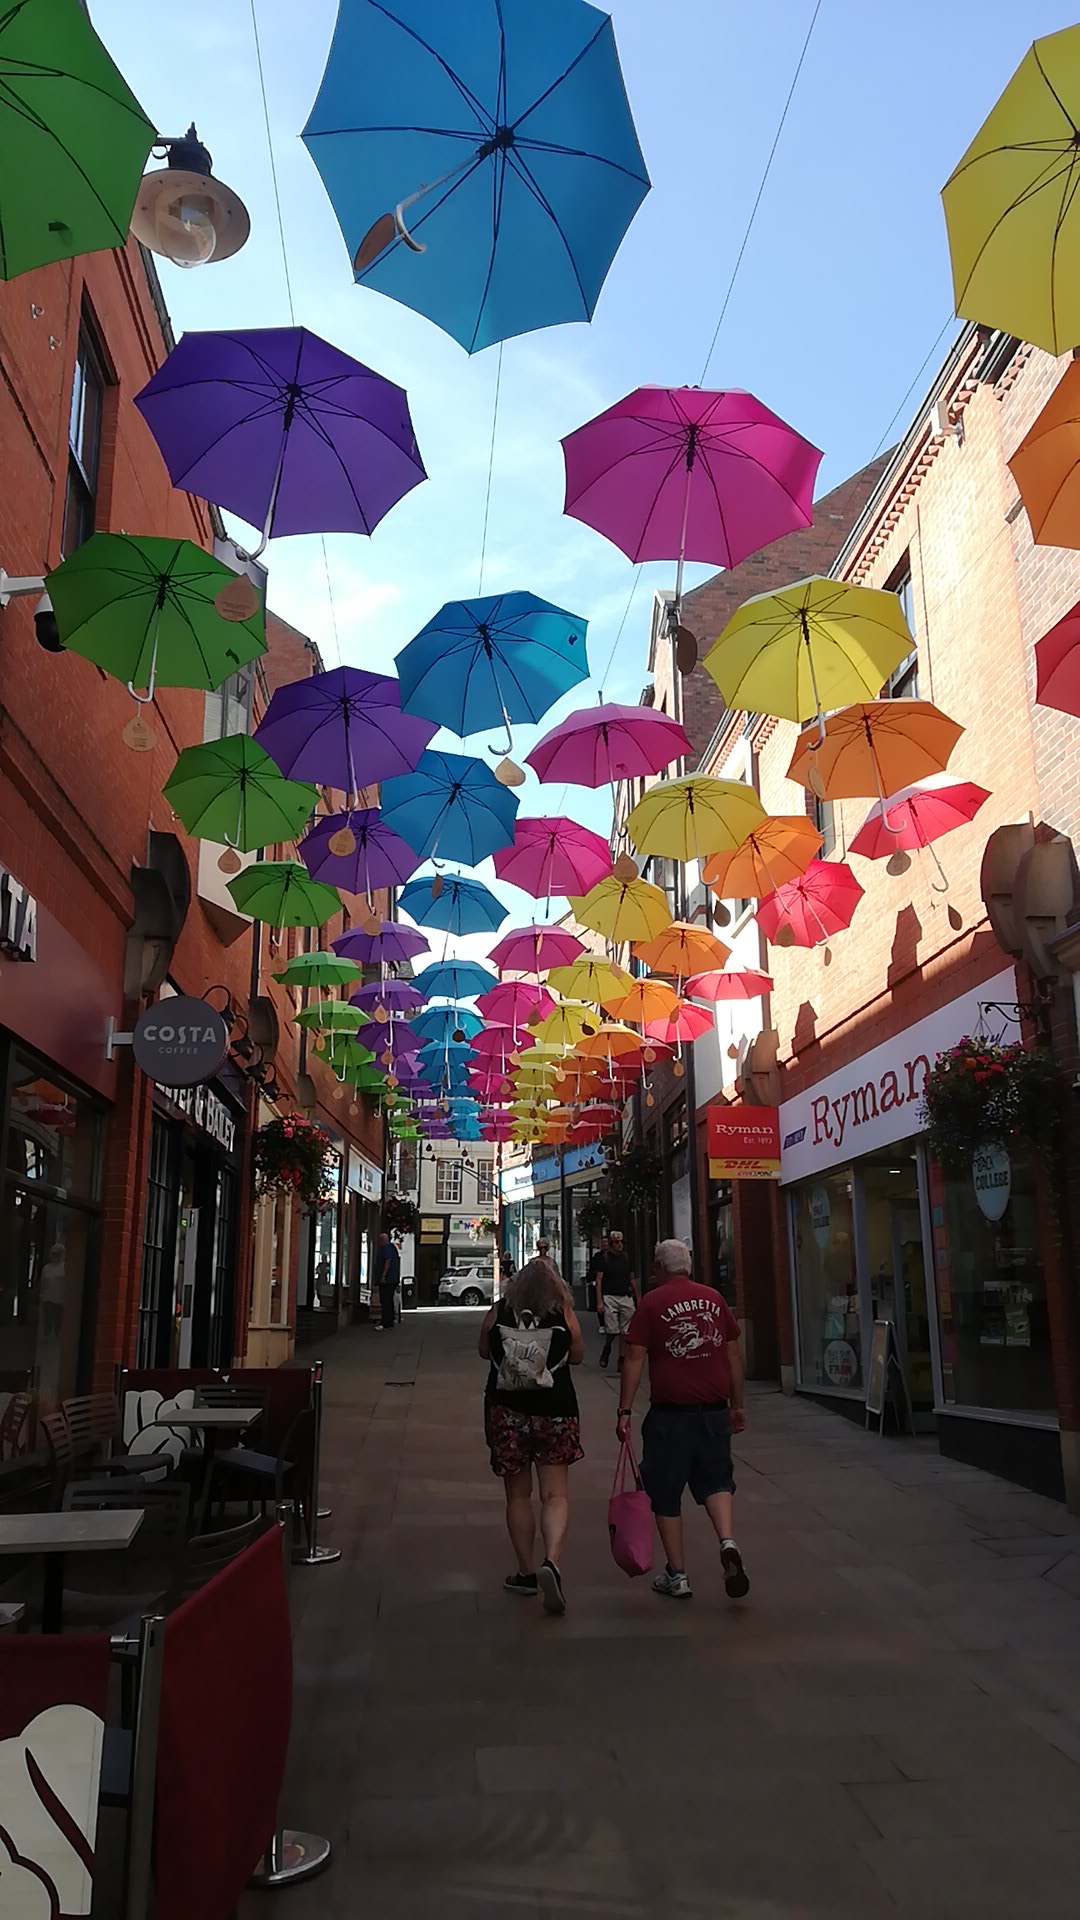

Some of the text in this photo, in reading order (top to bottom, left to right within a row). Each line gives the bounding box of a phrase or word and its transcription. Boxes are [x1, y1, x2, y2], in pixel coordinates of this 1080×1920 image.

[0, 864, 37, 962] TA
[143, 1025, 217, 1044] COSTA
[158, 1047, 198, 1055] COFFEE
[811, 1054, 932, 1147] Ryman
[206, 1089, 236, 1153] BAILEY
[715, 1124, 774, 1135] Ryman
[724, 1160, 763, 1169] DHL
[975, 1171, 1009, 1190] COLLEGE
[660, 1299, 721, 1322] LAMBRETTA
